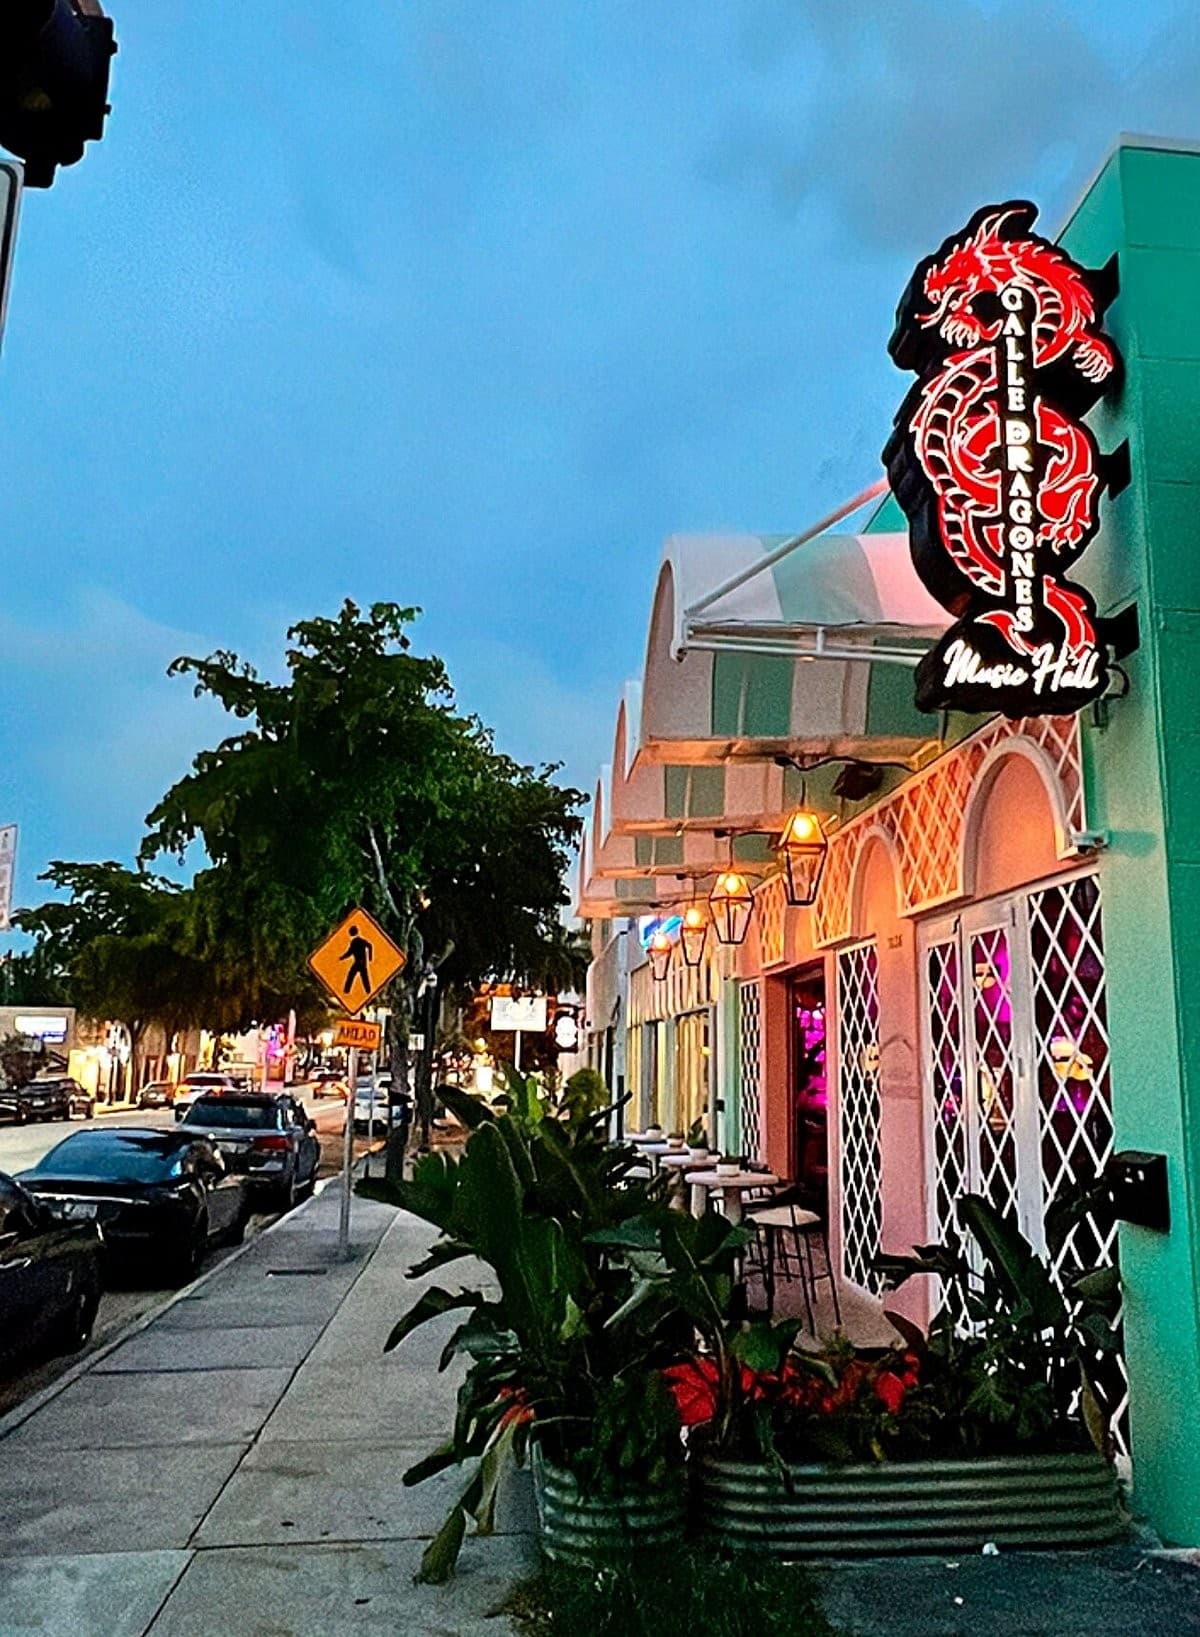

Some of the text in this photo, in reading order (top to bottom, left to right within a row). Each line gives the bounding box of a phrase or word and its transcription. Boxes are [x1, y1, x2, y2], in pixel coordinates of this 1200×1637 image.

[1001, 287, 1034, 632] CALLE DRAGONES
[943, 639, 1100, 695] Music Hall
